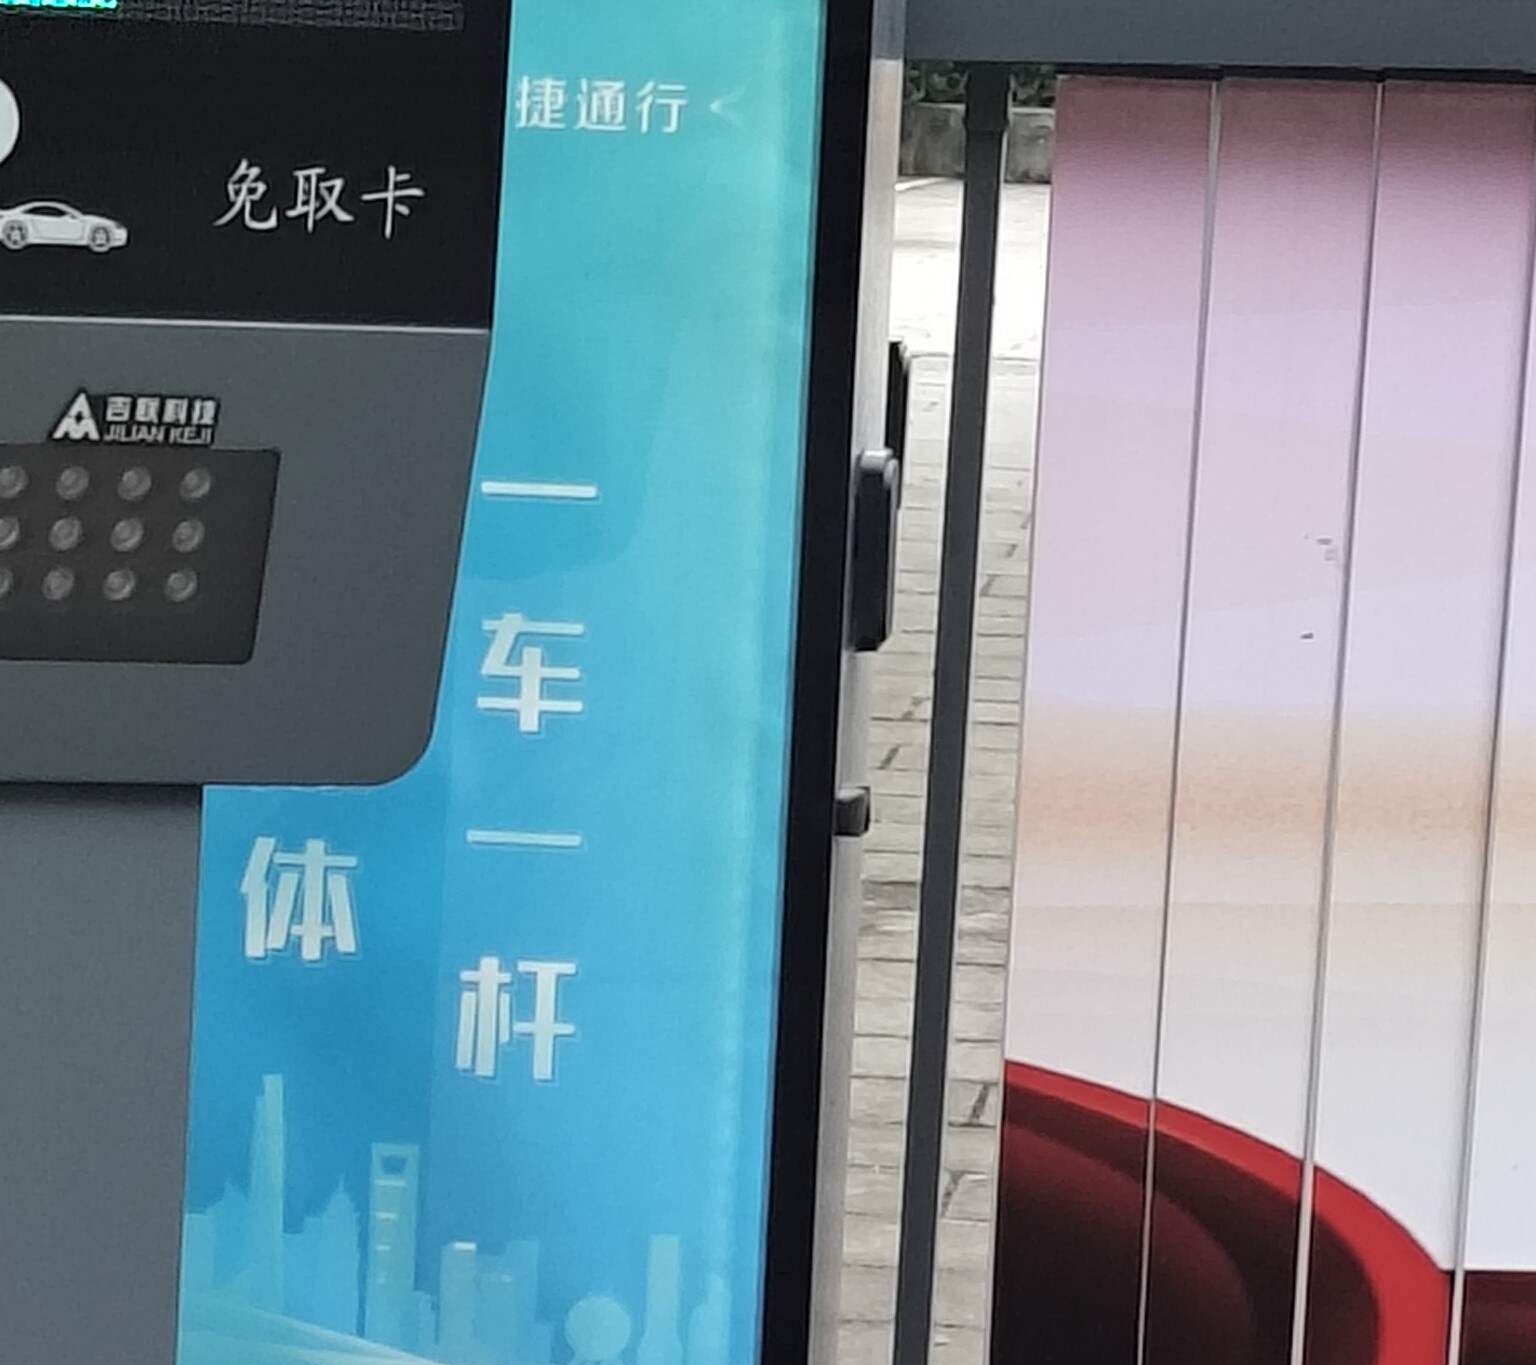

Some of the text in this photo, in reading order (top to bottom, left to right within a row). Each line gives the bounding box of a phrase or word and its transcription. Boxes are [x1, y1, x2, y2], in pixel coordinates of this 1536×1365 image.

[516, 75, 688, 134] 捷通行
[213, 157, 426, 240] 免取卡
[168, 425, 214, 445] KEJI
[241, 836, 358, 961] 体
